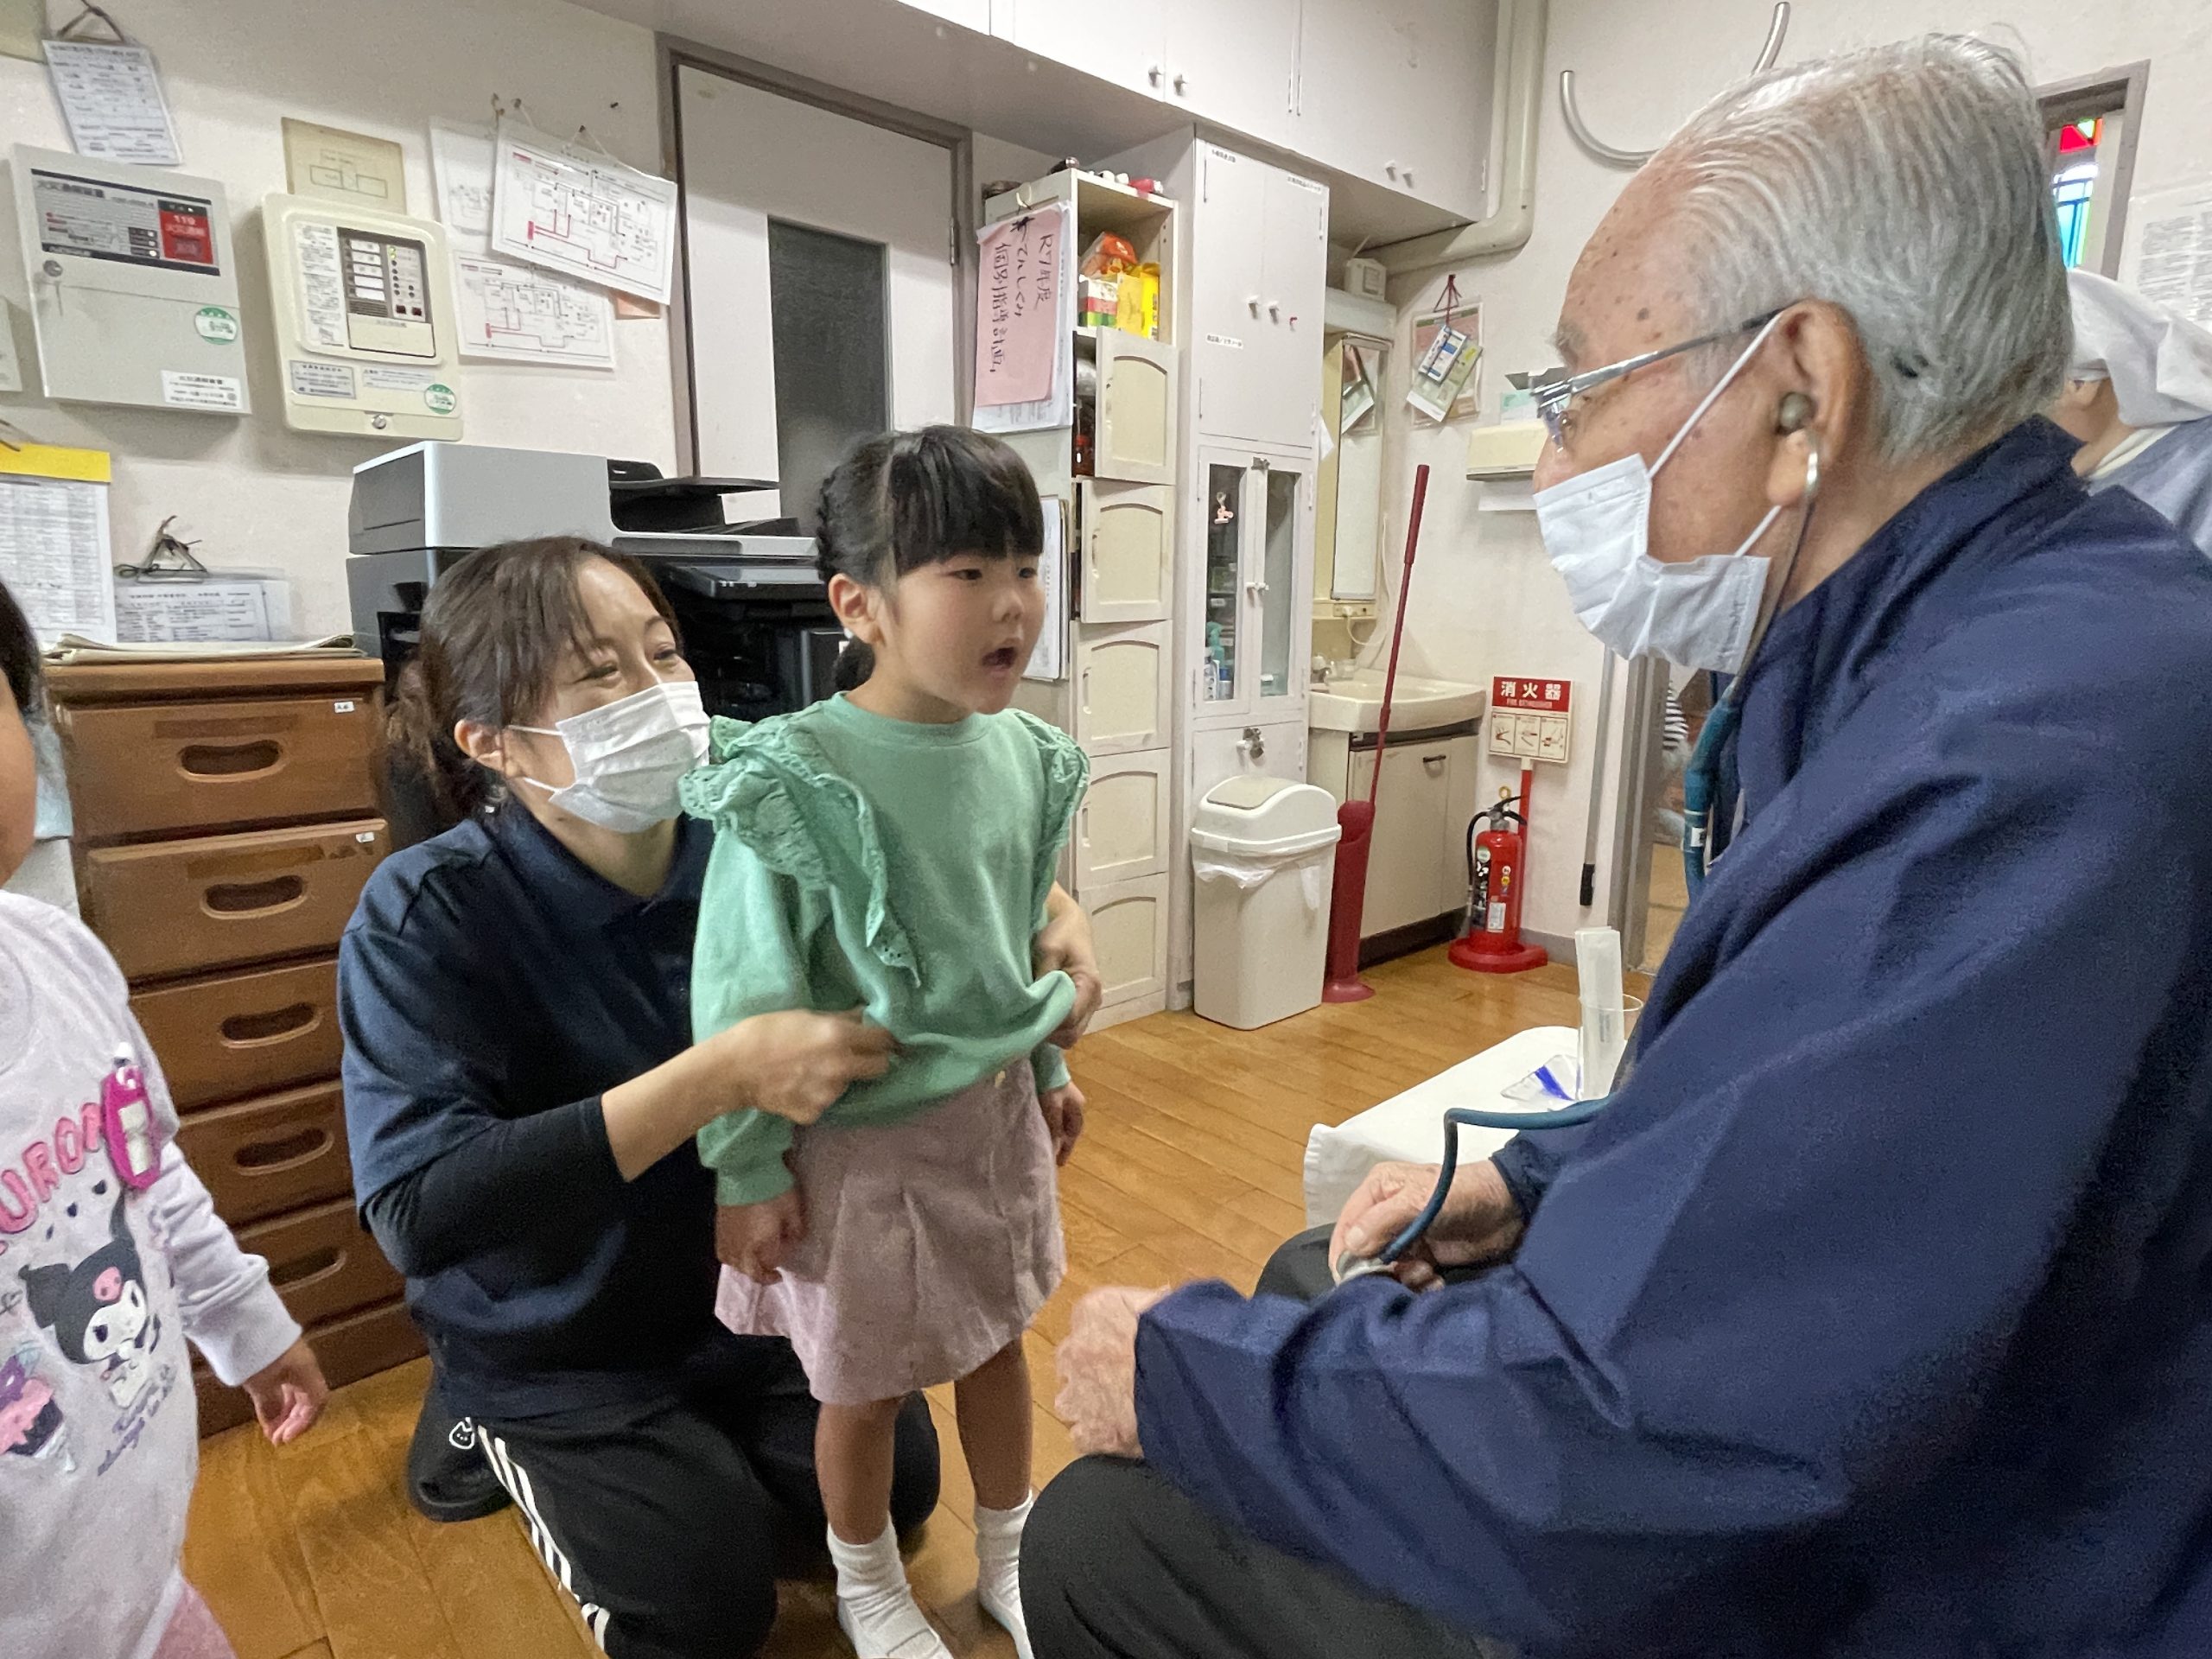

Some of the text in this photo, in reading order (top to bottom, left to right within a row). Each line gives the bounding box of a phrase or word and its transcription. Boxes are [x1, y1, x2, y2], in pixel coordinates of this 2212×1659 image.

[1501, 681, 1561, 701] 消火器
[0, 1102, 103, 1236] URO
